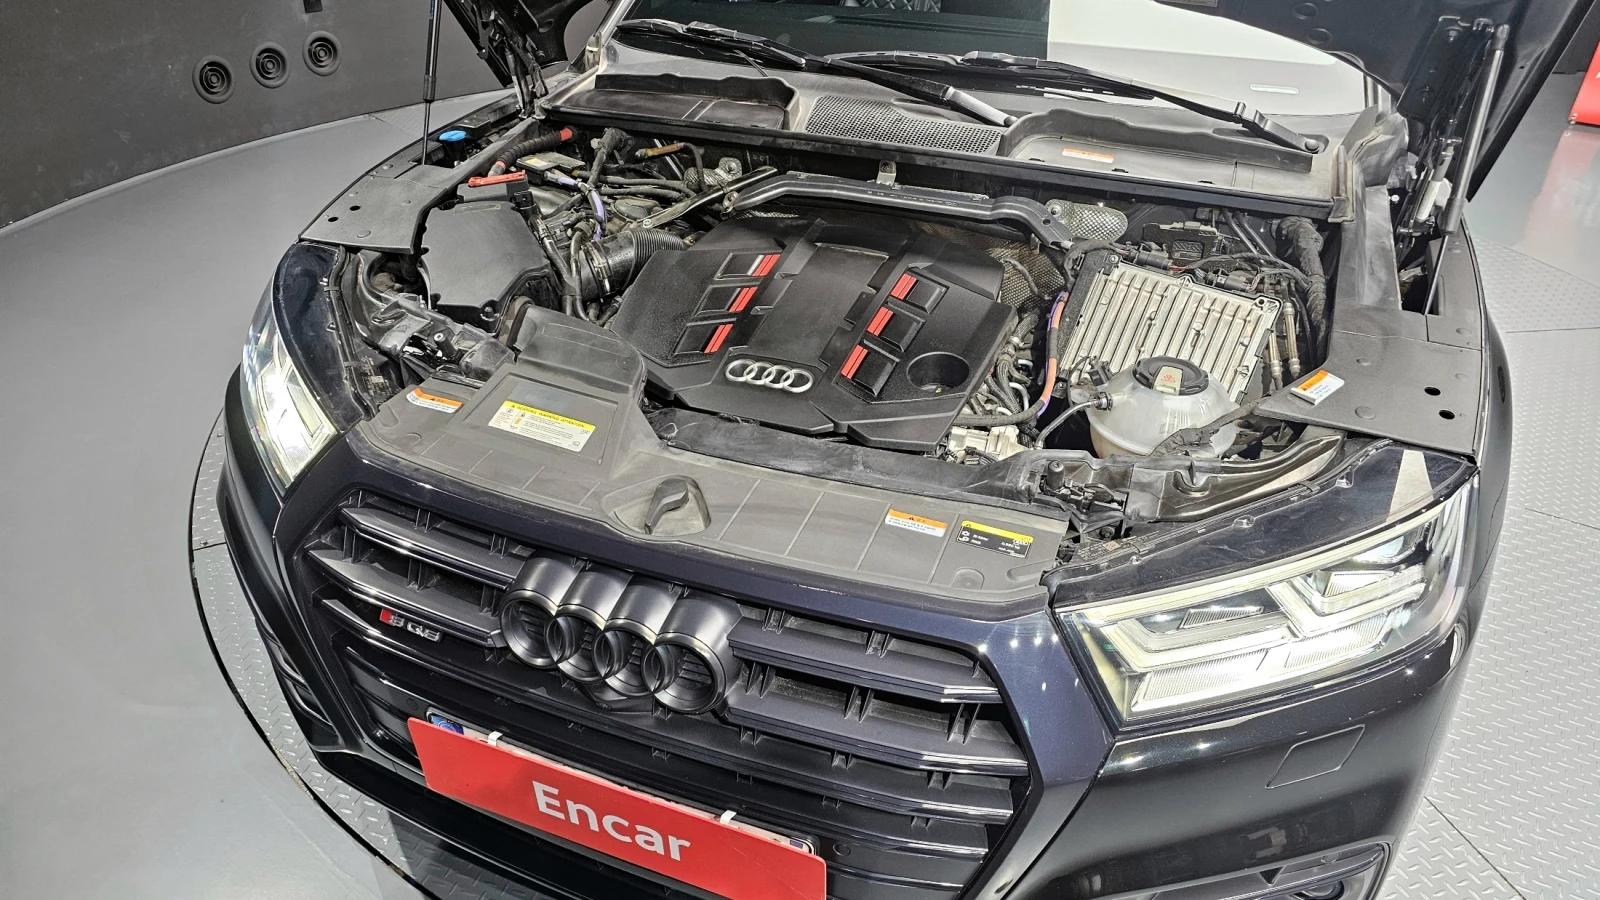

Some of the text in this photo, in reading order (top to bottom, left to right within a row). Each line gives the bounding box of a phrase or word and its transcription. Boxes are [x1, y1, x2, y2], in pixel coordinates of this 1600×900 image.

[538, 411, 560, 421] WARNING
[560, 418, 585, 428] ATTENTION
[532, 780, 691, 861] Encar
